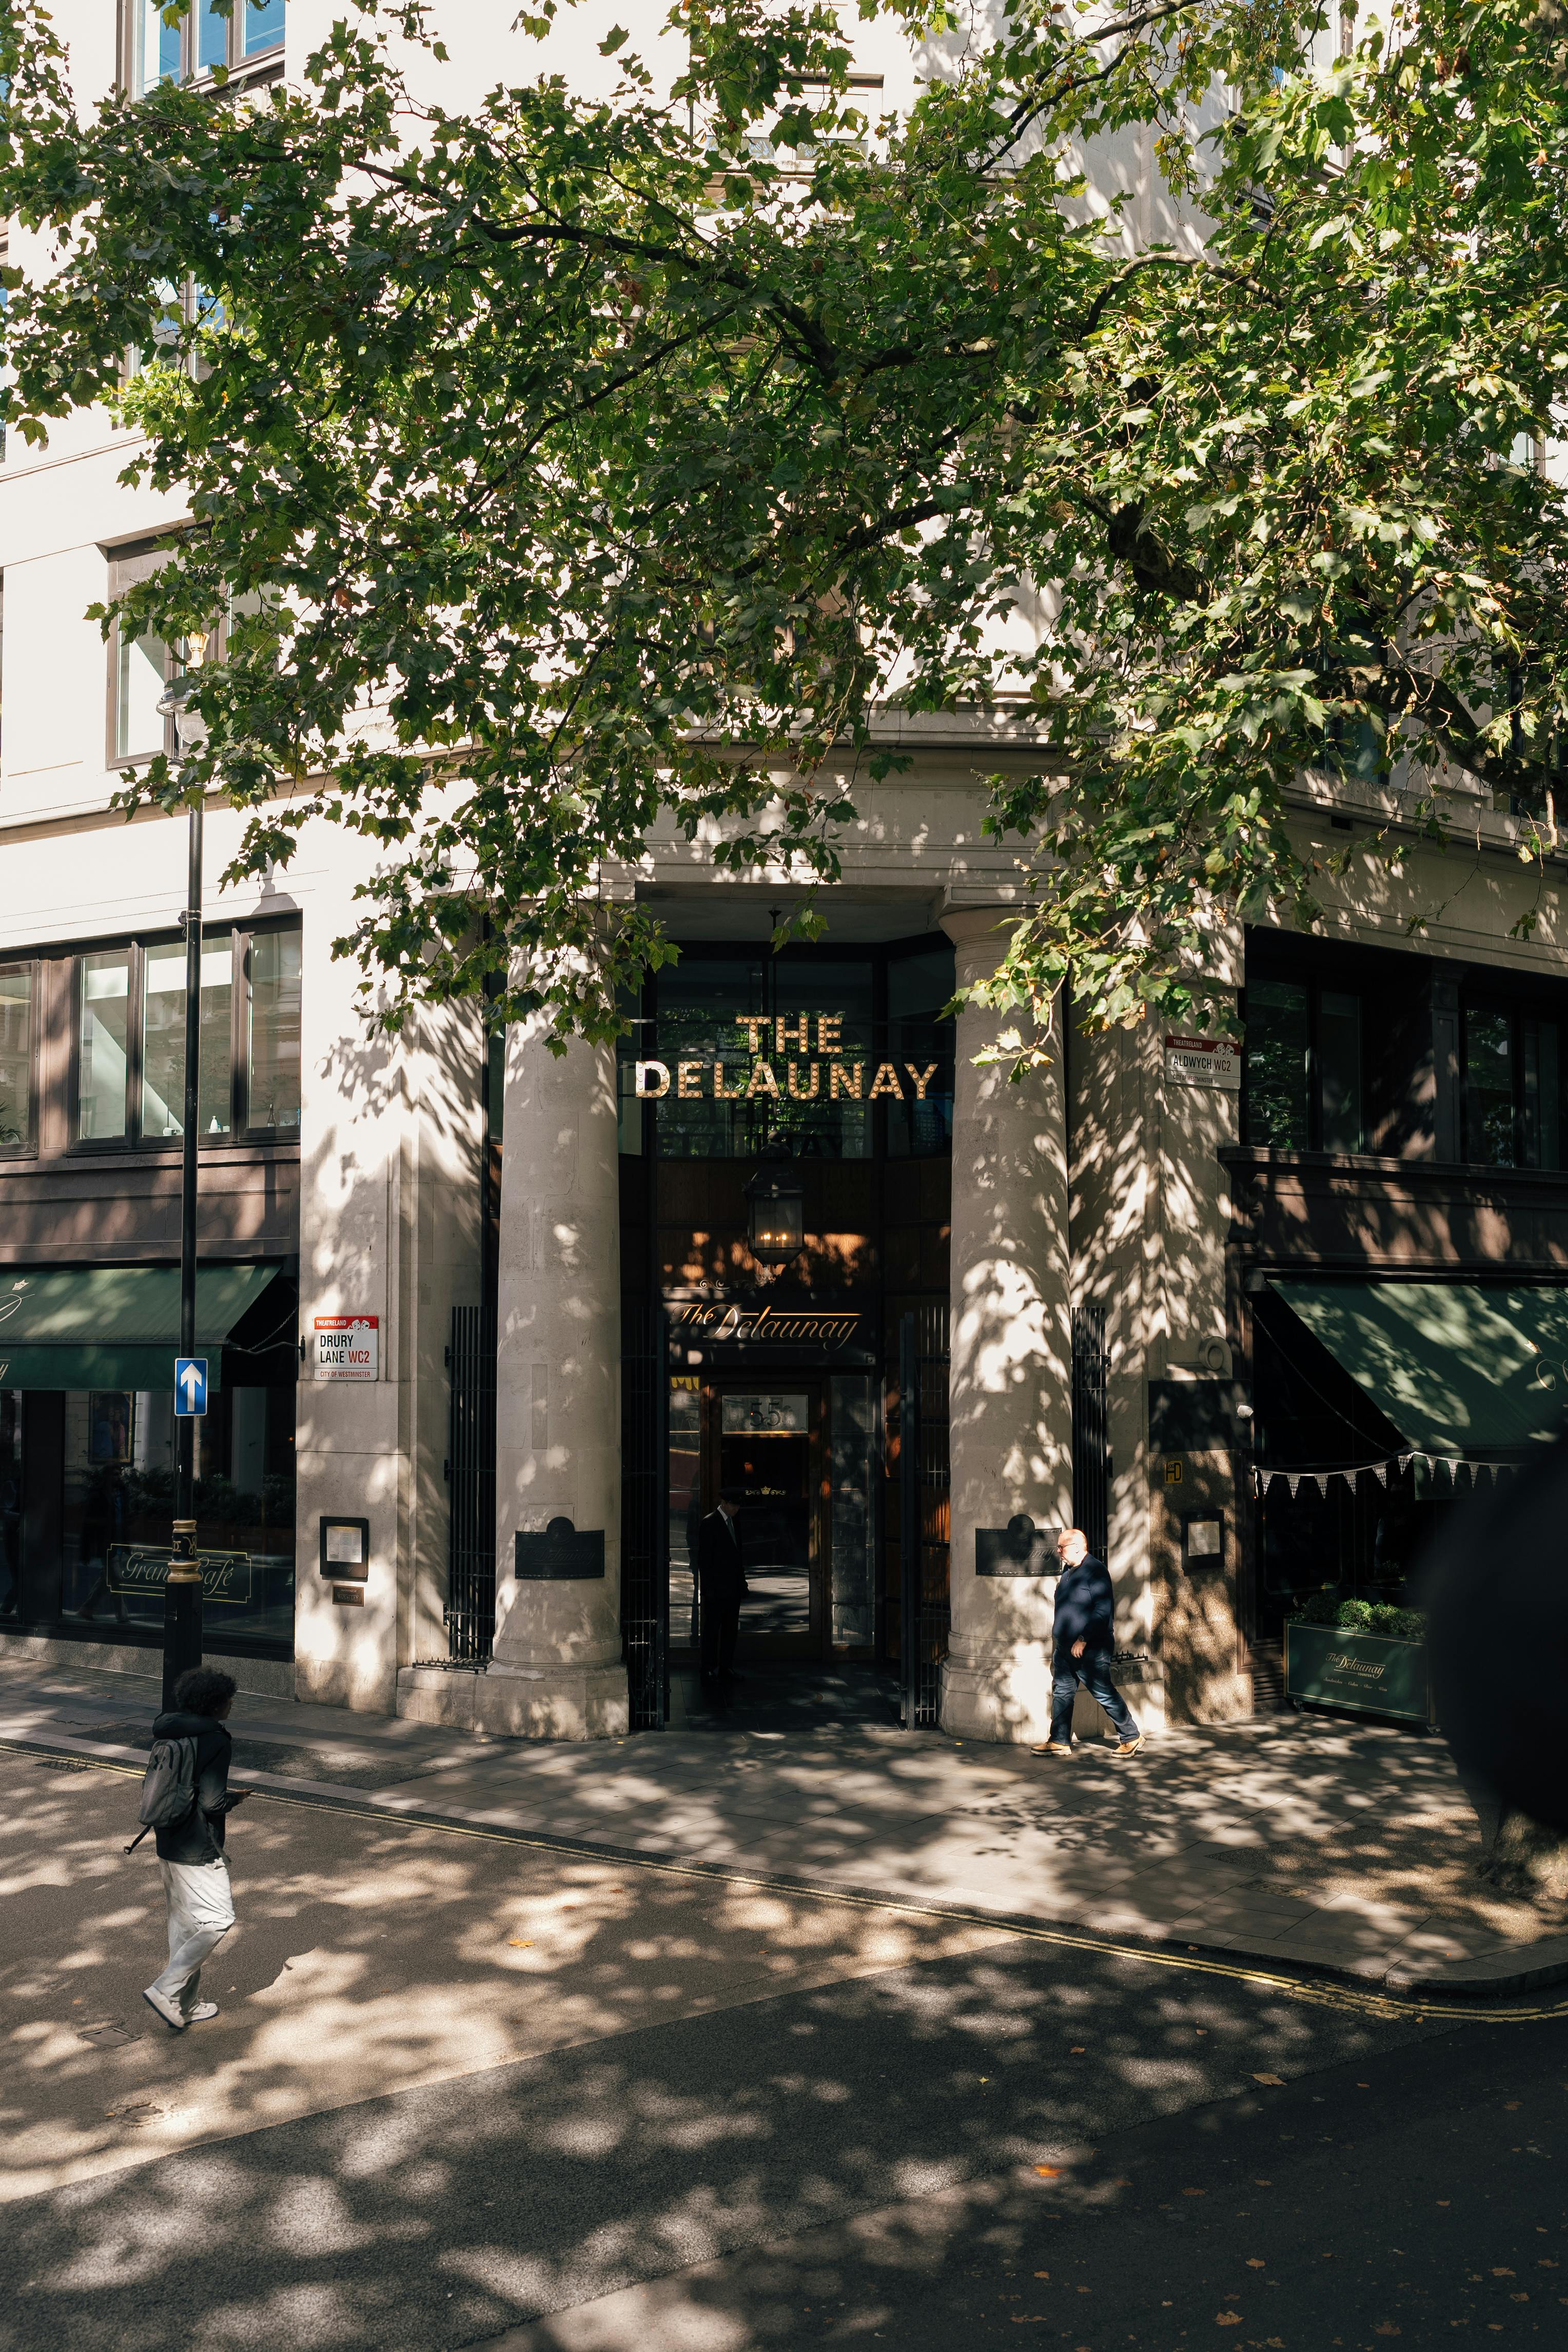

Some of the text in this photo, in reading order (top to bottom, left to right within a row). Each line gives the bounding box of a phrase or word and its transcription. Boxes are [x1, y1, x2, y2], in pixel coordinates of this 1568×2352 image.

[735, 1016, 843, 1053] THE
[1173, 1038, 1202, 1048] THEATRELAND
[1173, 1054, 1231, 1072] ALDWYCH WC2
[635, 1061, 938, 1100] DELAUNAY
[670, 1303, 859, 1350] The Delaunay
[320, 1335, 354, 1347] DRURY
[320, 1350, 369, 1363] LANE WC2
[749, 1402, 782, 1427] 55
[122, 1551, 168, 1580] Gran
[1326, 1653, 1385, 1679] The Delaunay
